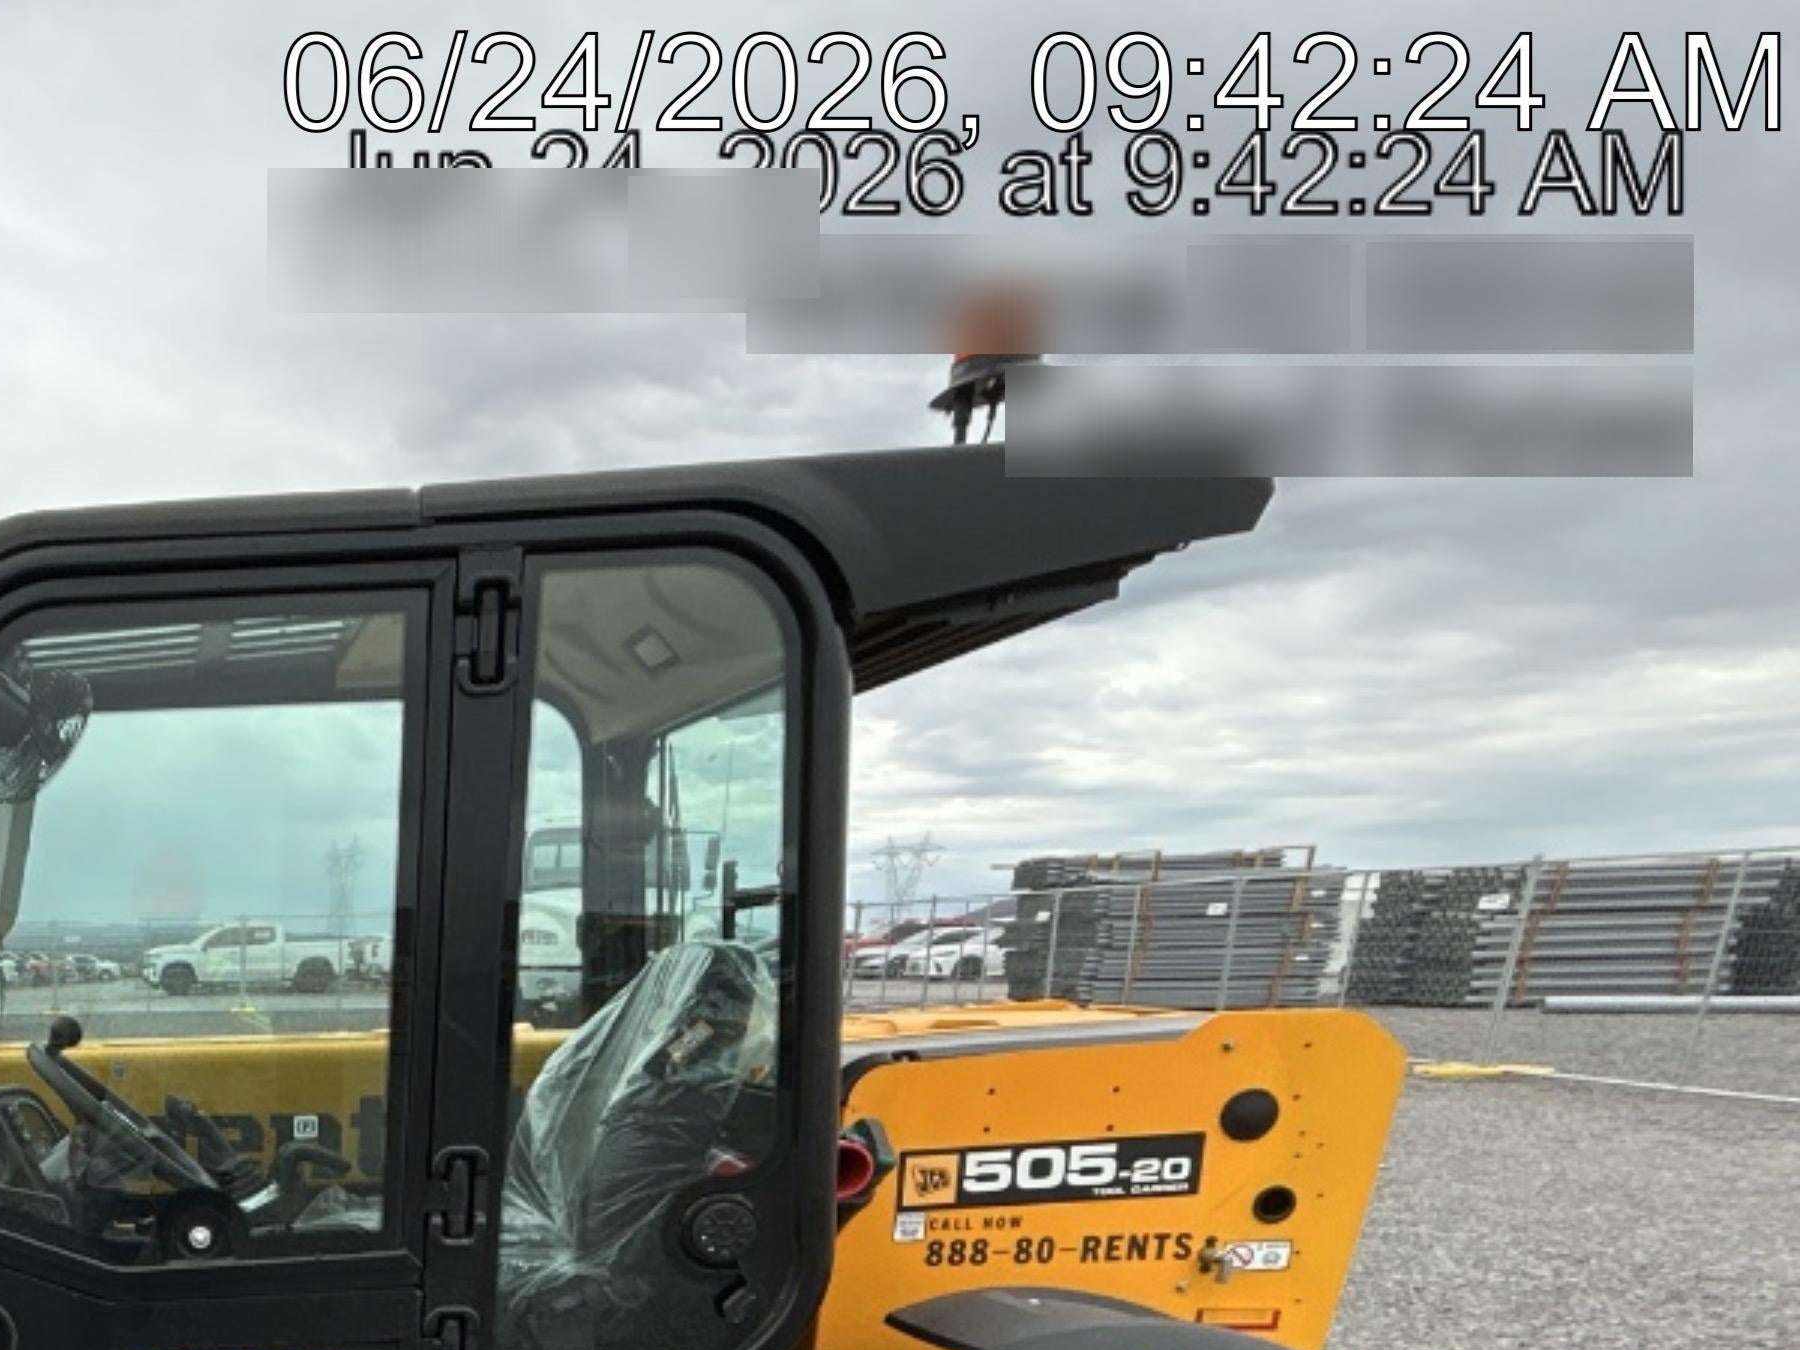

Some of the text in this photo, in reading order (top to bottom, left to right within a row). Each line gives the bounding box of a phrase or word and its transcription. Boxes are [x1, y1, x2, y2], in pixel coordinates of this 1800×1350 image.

[962, 1143, 1192, 1192] 505-20
[929, 1217, 972, 1231] CALL
[983, 1214, 1023, 1230] NOW
